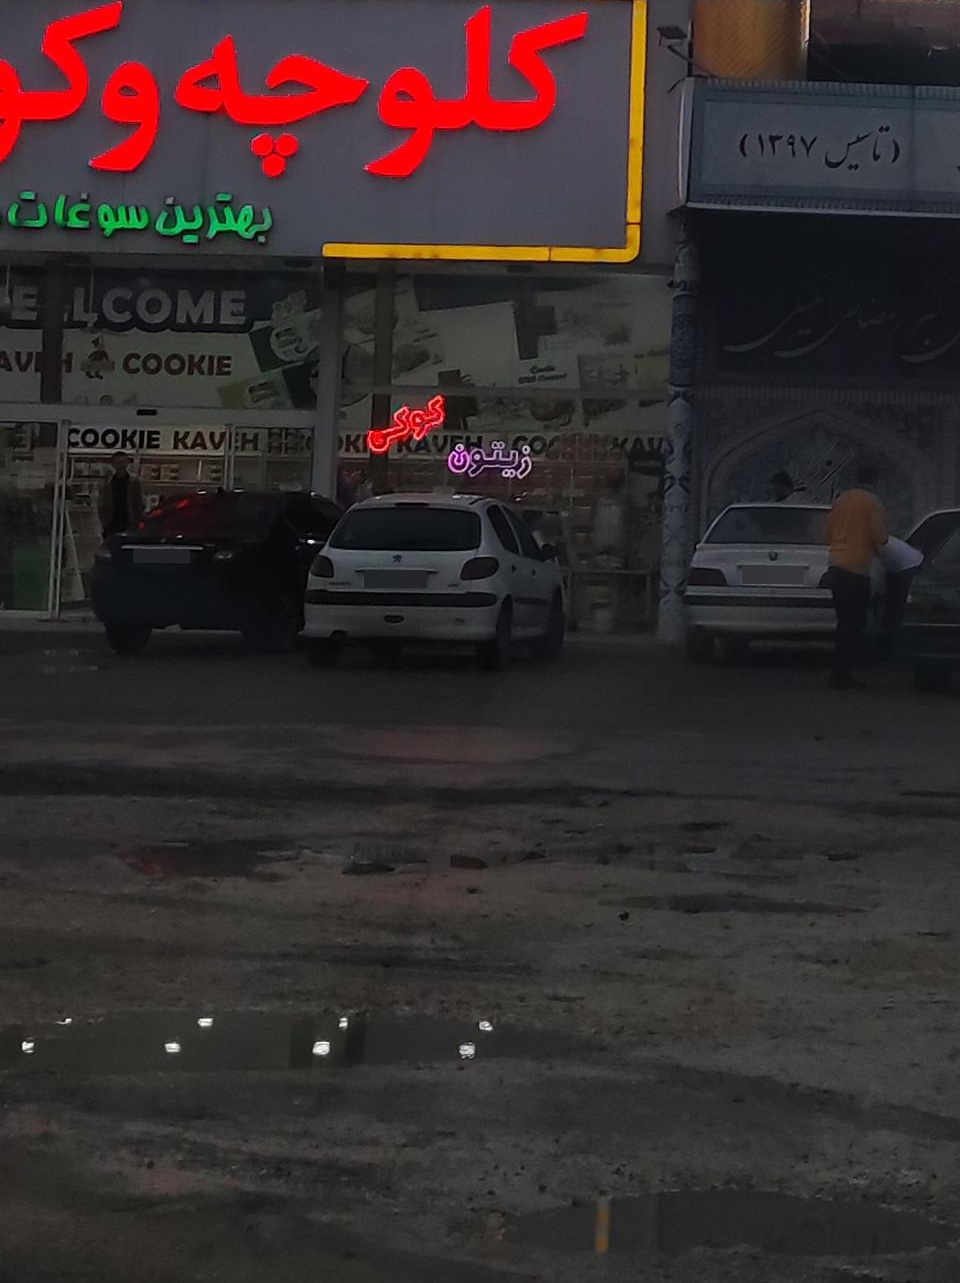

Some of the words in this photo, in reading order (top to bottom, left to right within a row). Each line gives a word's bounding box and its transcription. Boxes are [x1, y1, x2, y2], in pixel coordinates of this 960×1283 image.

[175, 5, 589, 177] کلوچه
[90, 60, 160, 172] و
[8, 190, 151, 237] سوغات
[155, 192, 273, 244] بهترین
[122, 351, 232, 377] COOKIE
[68, 427, 161, 449] COOKIE
[366, 395, 447, 454] کوکی
[447, 441, 532, 479] زیتون
